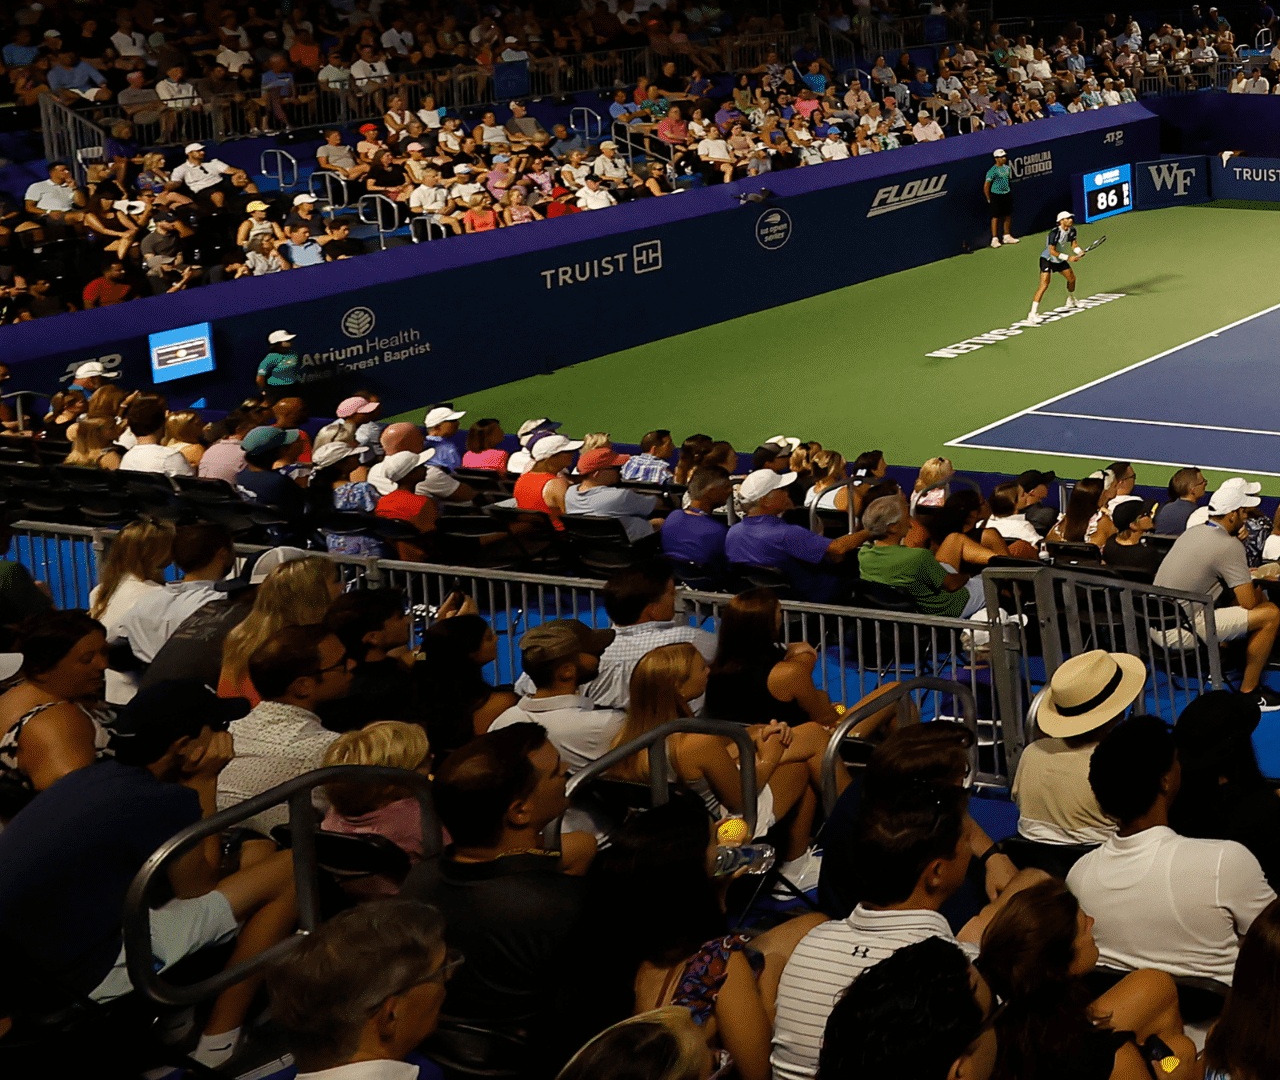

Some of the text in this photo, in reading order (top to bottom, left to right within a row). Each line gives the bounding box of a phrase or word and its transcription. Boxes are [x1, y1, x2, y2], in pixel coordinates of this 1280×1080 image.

[871, 173, 948, 208] FLOW
[1122, 182, 1130, 206] MPH
[1148, 163, 1195, 196] WF
[1097, 189, 1118, 210] 86
[540, 252, 628, 290] TRUIST
[302, 327, 421, 367] Atrium Health
[383, 341, 431, 364] Baptist
